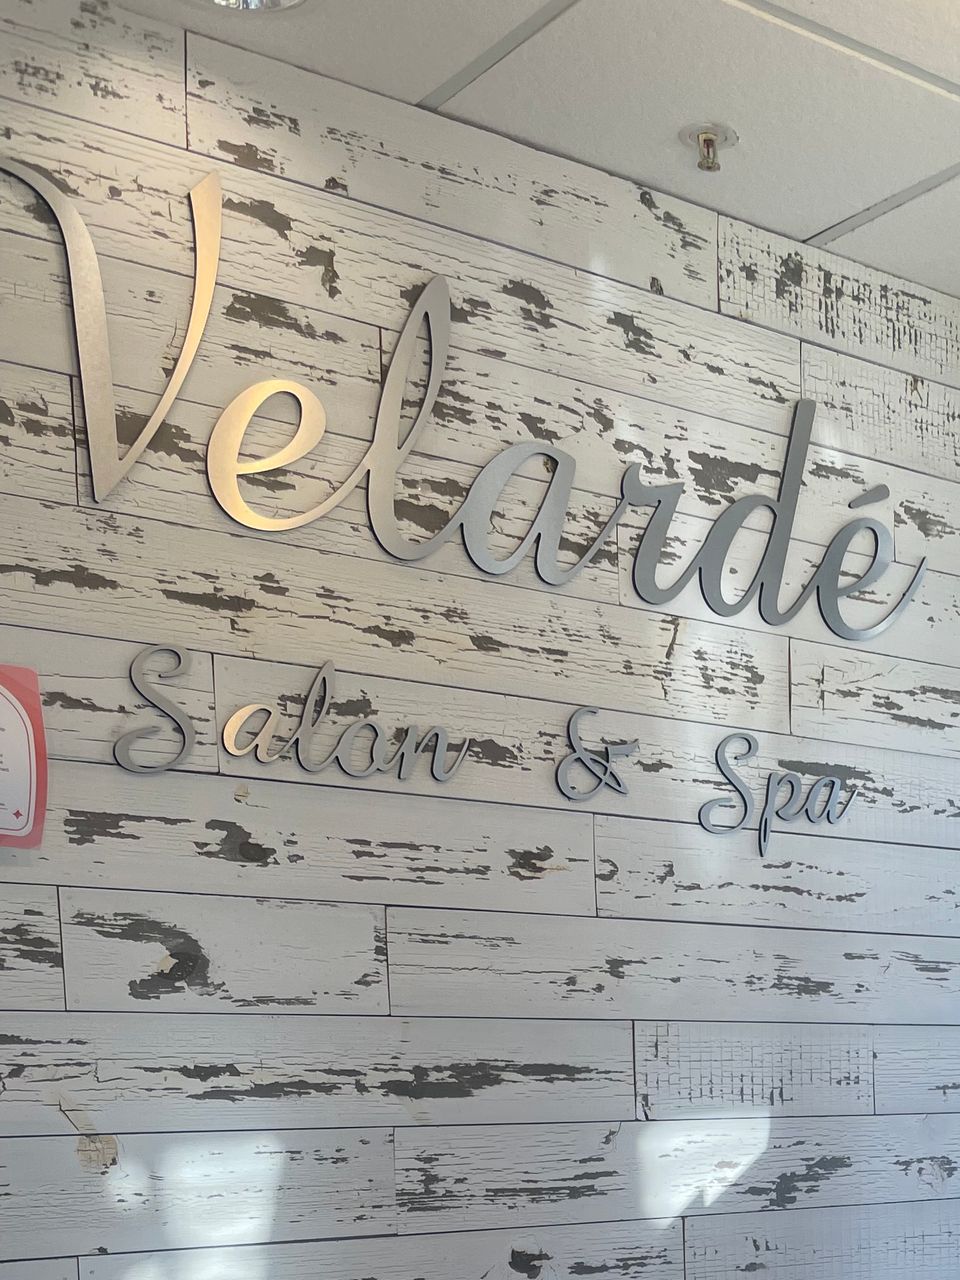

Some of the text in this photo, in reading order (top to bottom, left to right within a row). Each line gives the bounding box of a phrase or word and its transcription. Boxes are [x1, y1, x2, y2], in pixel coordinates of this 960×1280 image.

[0, 167, 928, 641] Velardé
[112, 645, 473, 784] Salon
[554, 705, 639, 803] &
[697, 732, 858, 857] Spa
